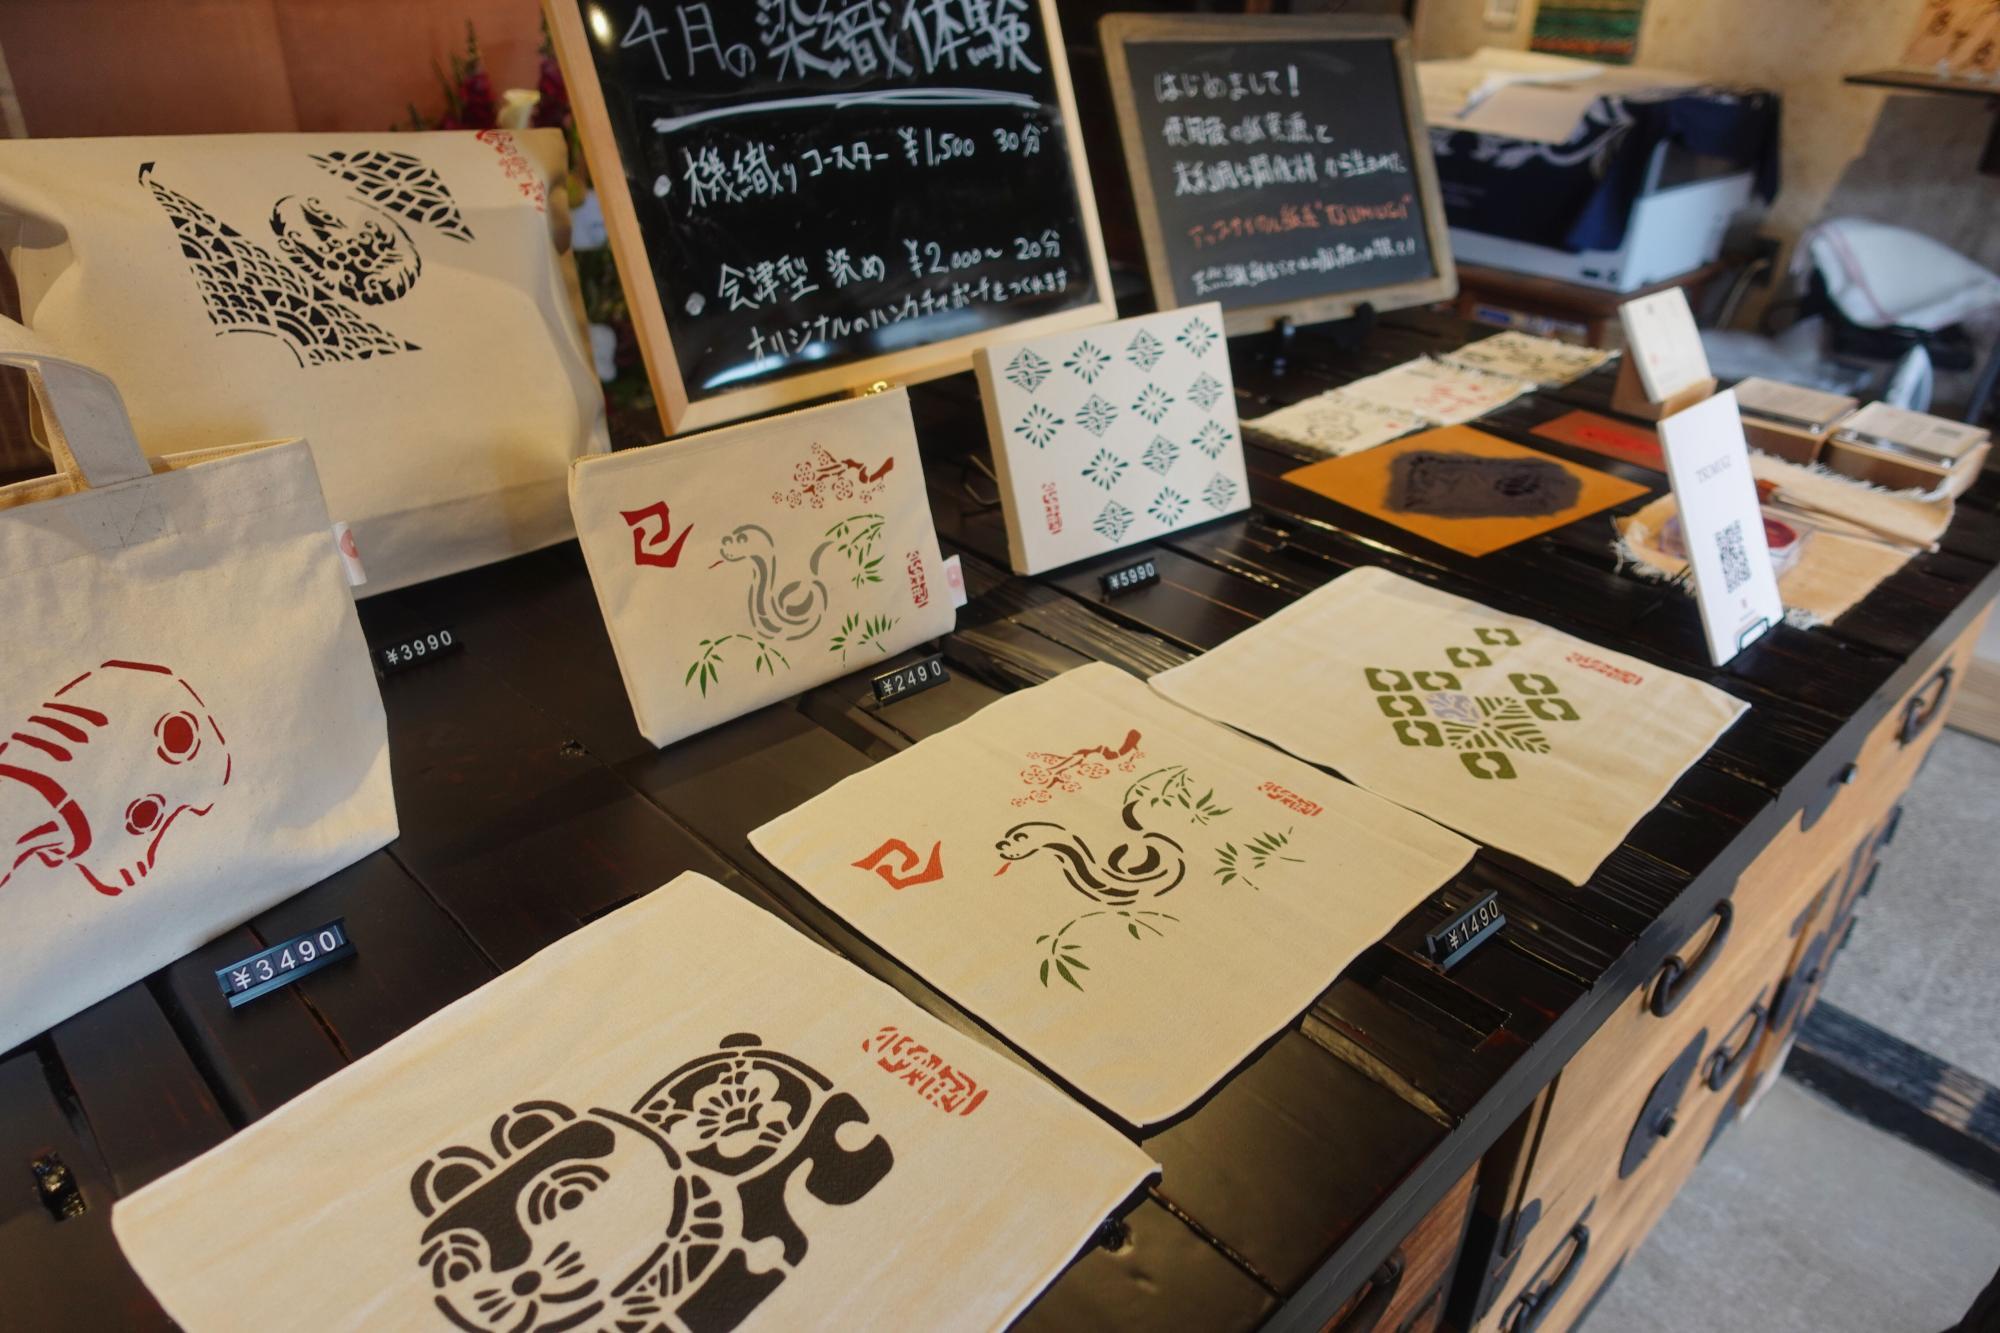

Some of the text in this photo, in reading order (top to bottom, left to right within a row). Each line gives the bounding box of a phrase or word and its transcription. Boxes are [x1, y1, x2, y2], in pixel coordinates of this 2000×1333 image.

[1013, 229, 1061, 260] 20分
[1109, 562, 1155, 589] ¥5990
[385, 630, 452, 665] ¥3990
[882, 660, 942, 695] ¥2490
[1448, 900, 1498, 950] ¥1490
[232, 931, 337, 990] ¥3490
